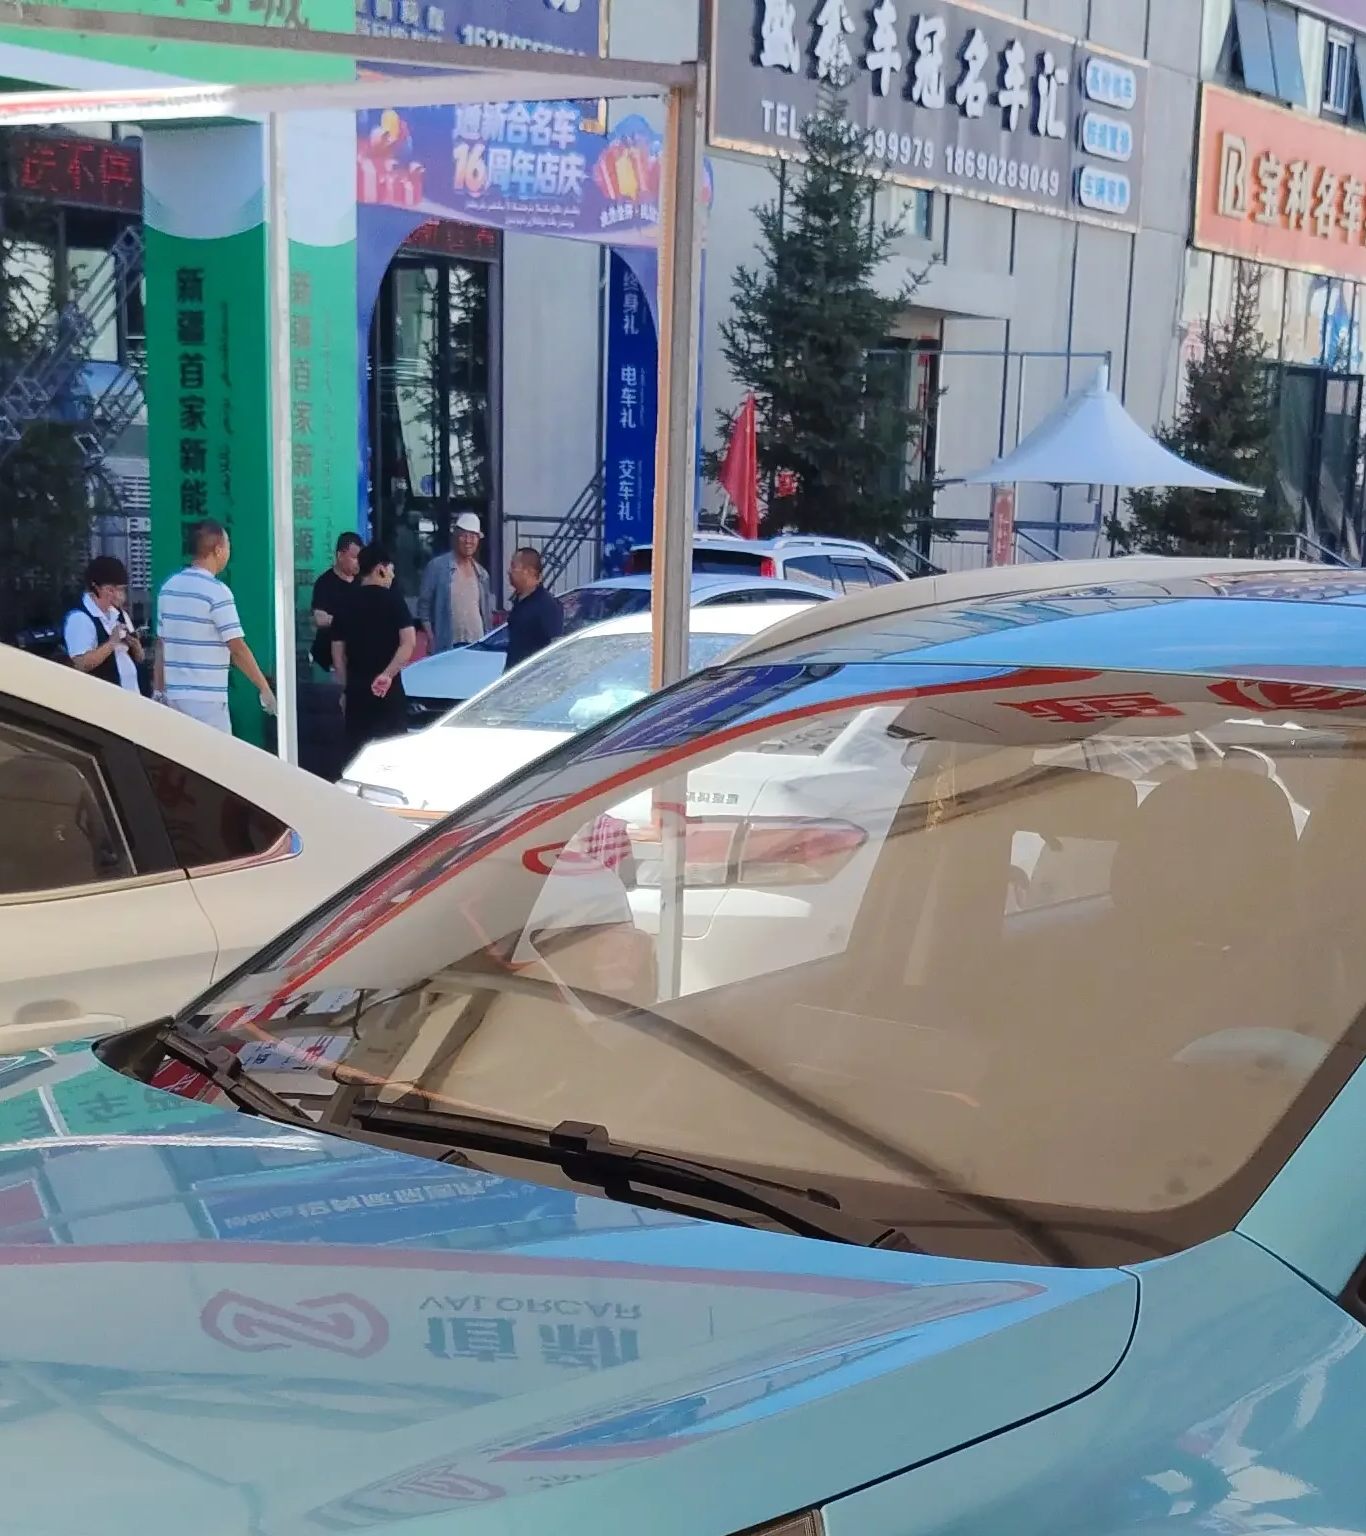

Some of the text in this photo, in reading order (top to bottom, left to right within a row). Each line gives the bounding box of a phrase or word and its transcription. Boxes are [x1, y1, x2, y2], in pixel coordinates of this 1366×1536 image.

[453, 146, 585, 199] 16周年店庆
[761, 99, 800, 139] TEL
[945, 145, 1060, 197] 18690289049
[619, 365, 638, 430] 电车礼
[618, 459, 636, 522] 交车礼
